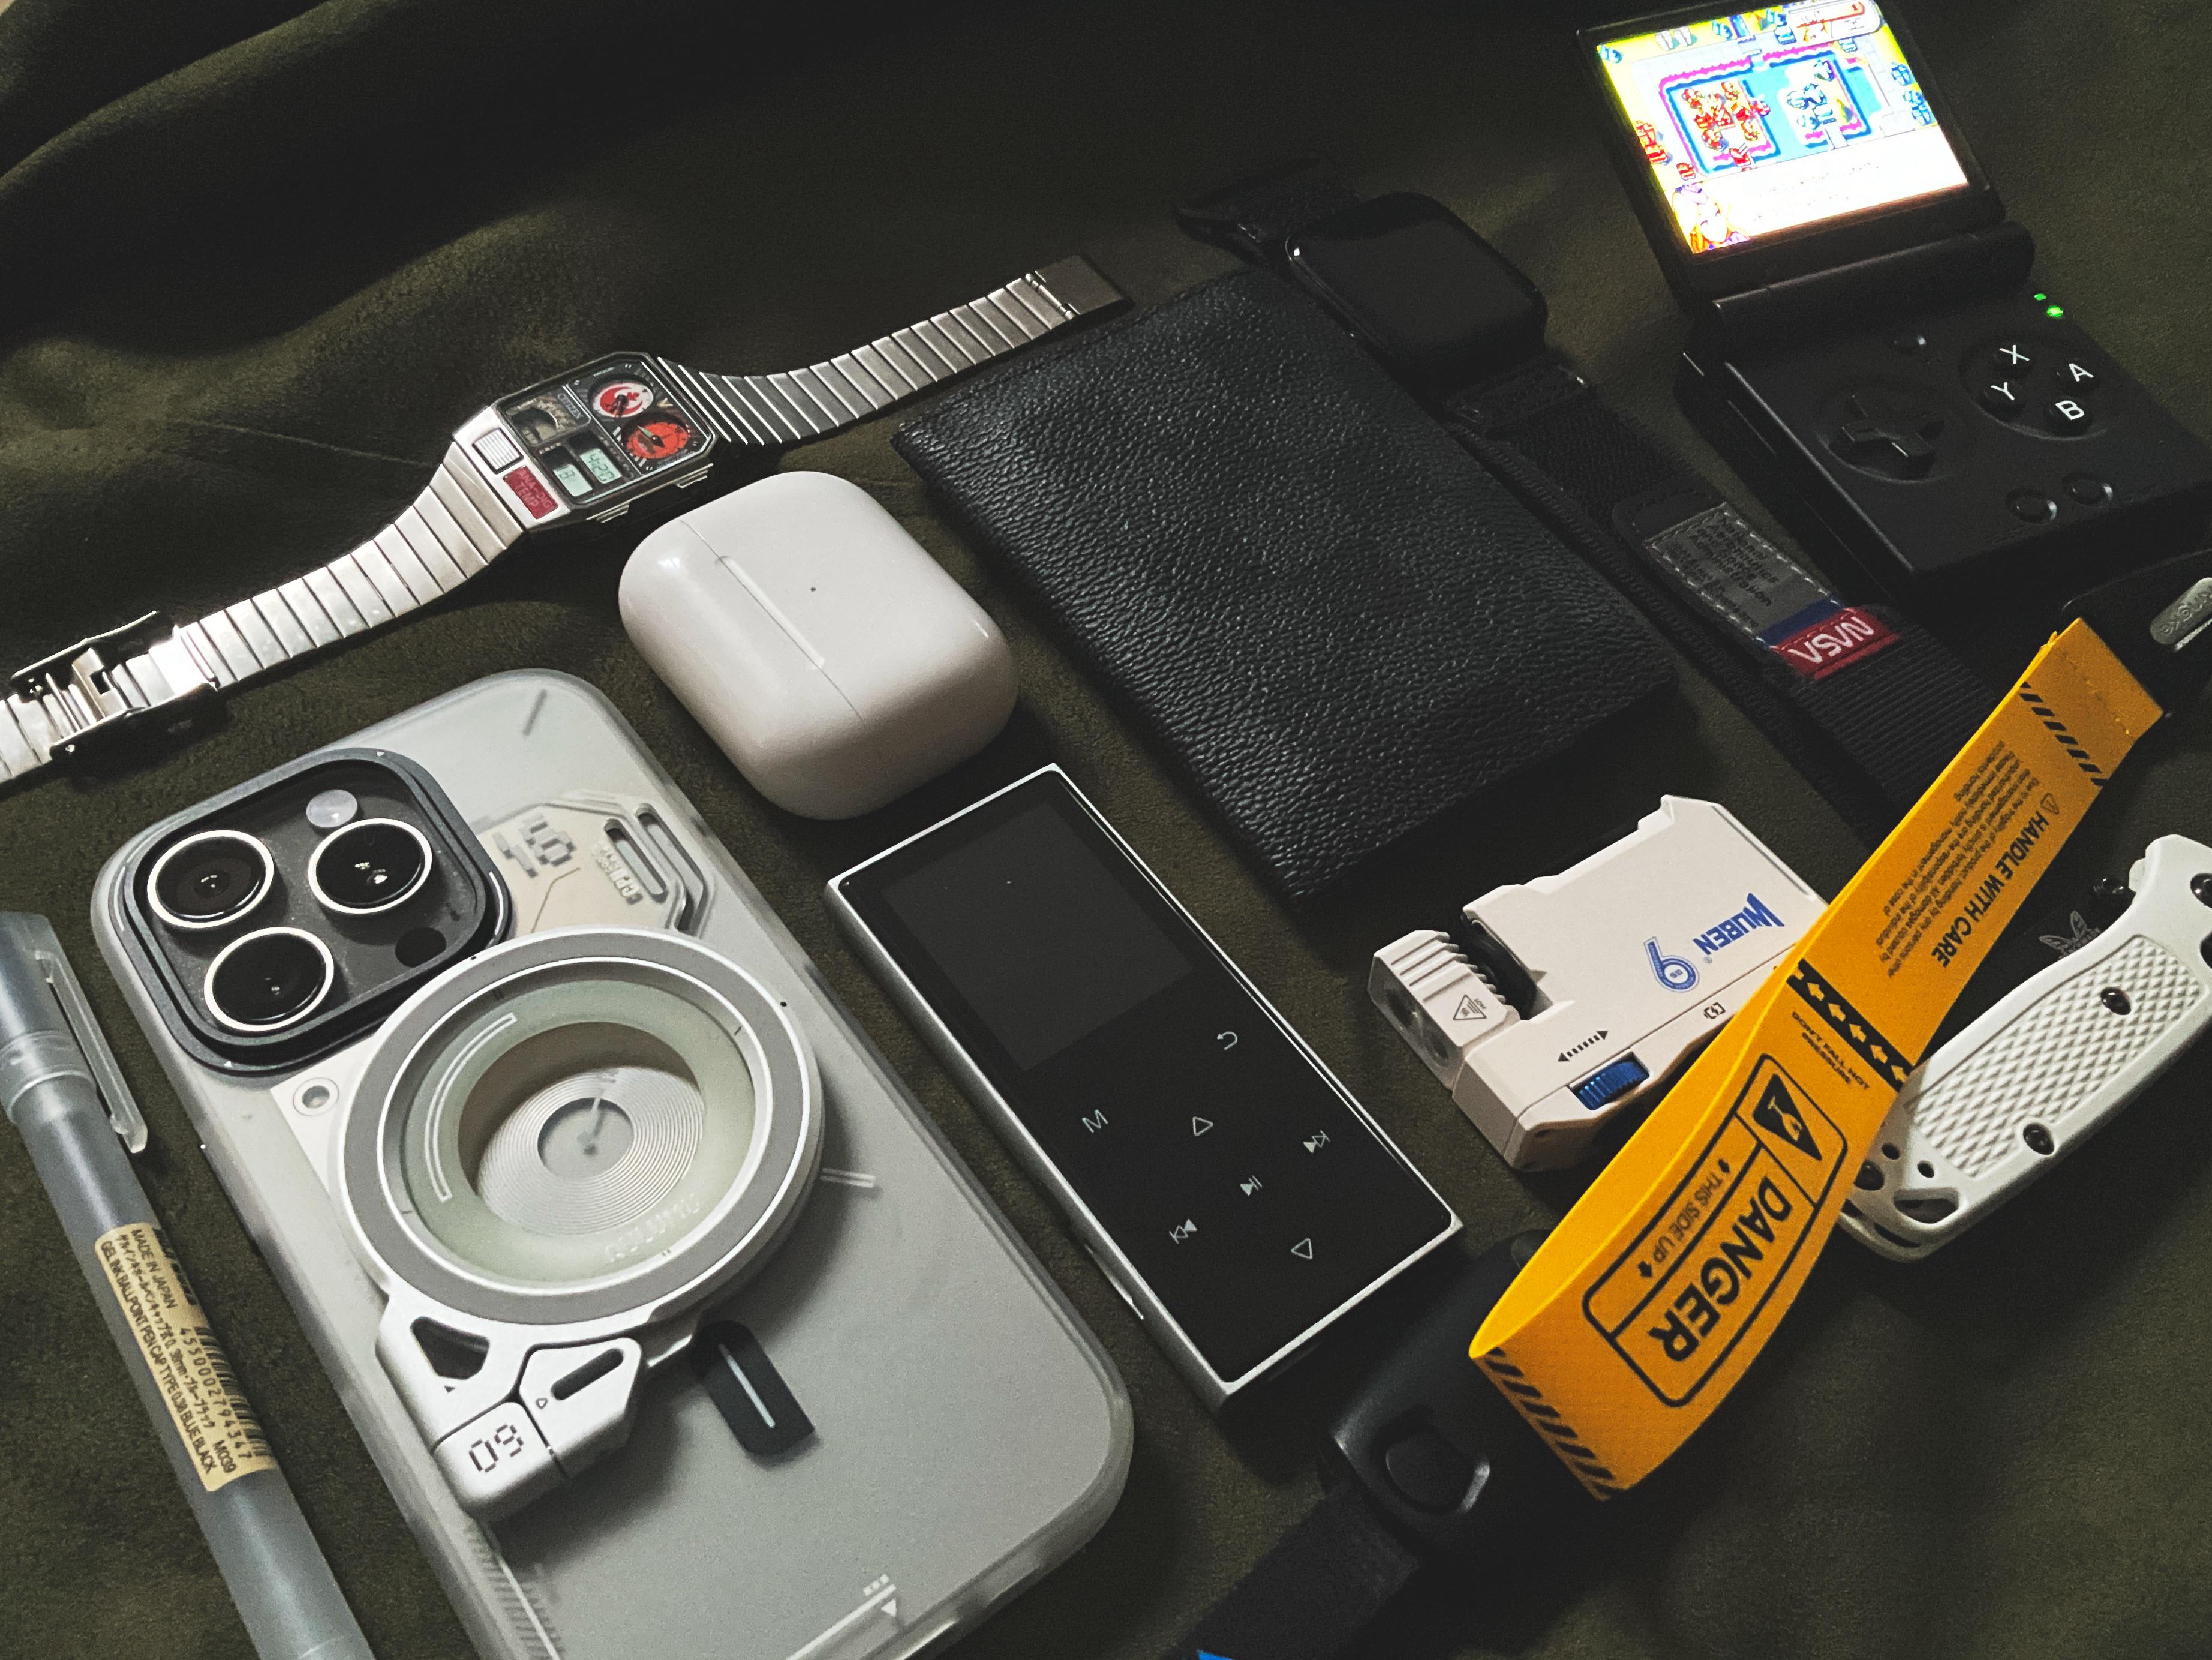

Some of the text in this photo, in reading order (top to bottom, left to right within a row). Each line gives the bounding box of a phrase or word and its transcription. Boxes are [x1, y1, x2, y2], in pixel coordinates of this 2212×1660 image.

[1999, 344, 2030, 365] X
[2069, 363, 2094, 382] A
[557, 394, 584, 419] CITIZEN
[1991, 382, 2015, 401] Y
[2055, 400, 2084, 420] B
[517, 484, 540, 507] TEMP
[1788, 616, 1874, 664] NASA
[1931, 811, 2049, 968] HANDLE WITH CARE
[1693, 893, 1784, 955] WUBEN
[1082, 1110, 1108, 1133] M
[1652, 1173, 1724, 1264] THIS SIDE UP
[131, 1229, 154, 1260] MADE
[146, 1261, 160, 1272] IN
[1649, 1176, 1793, 1362] DANGER
[152, 1275, 178, 1309] JAPAN
[101, 1241, 117, 1262] GEL
[110, 1259, 125, 1277] INK
[141, 1325, 156, 1347] PEN
[150, 1345, 167, 1365] CAP
[159, 1365, 180, 1394] TYPE
[180, 1410, 203, 1439] BLUE
[193, 1436, 217, 1474] BLACK
[179, 1328, 253, 1459] 4550002794347
[212, 1439, 237, 1473] M039
[469, 1424, 525, 1473] 09
